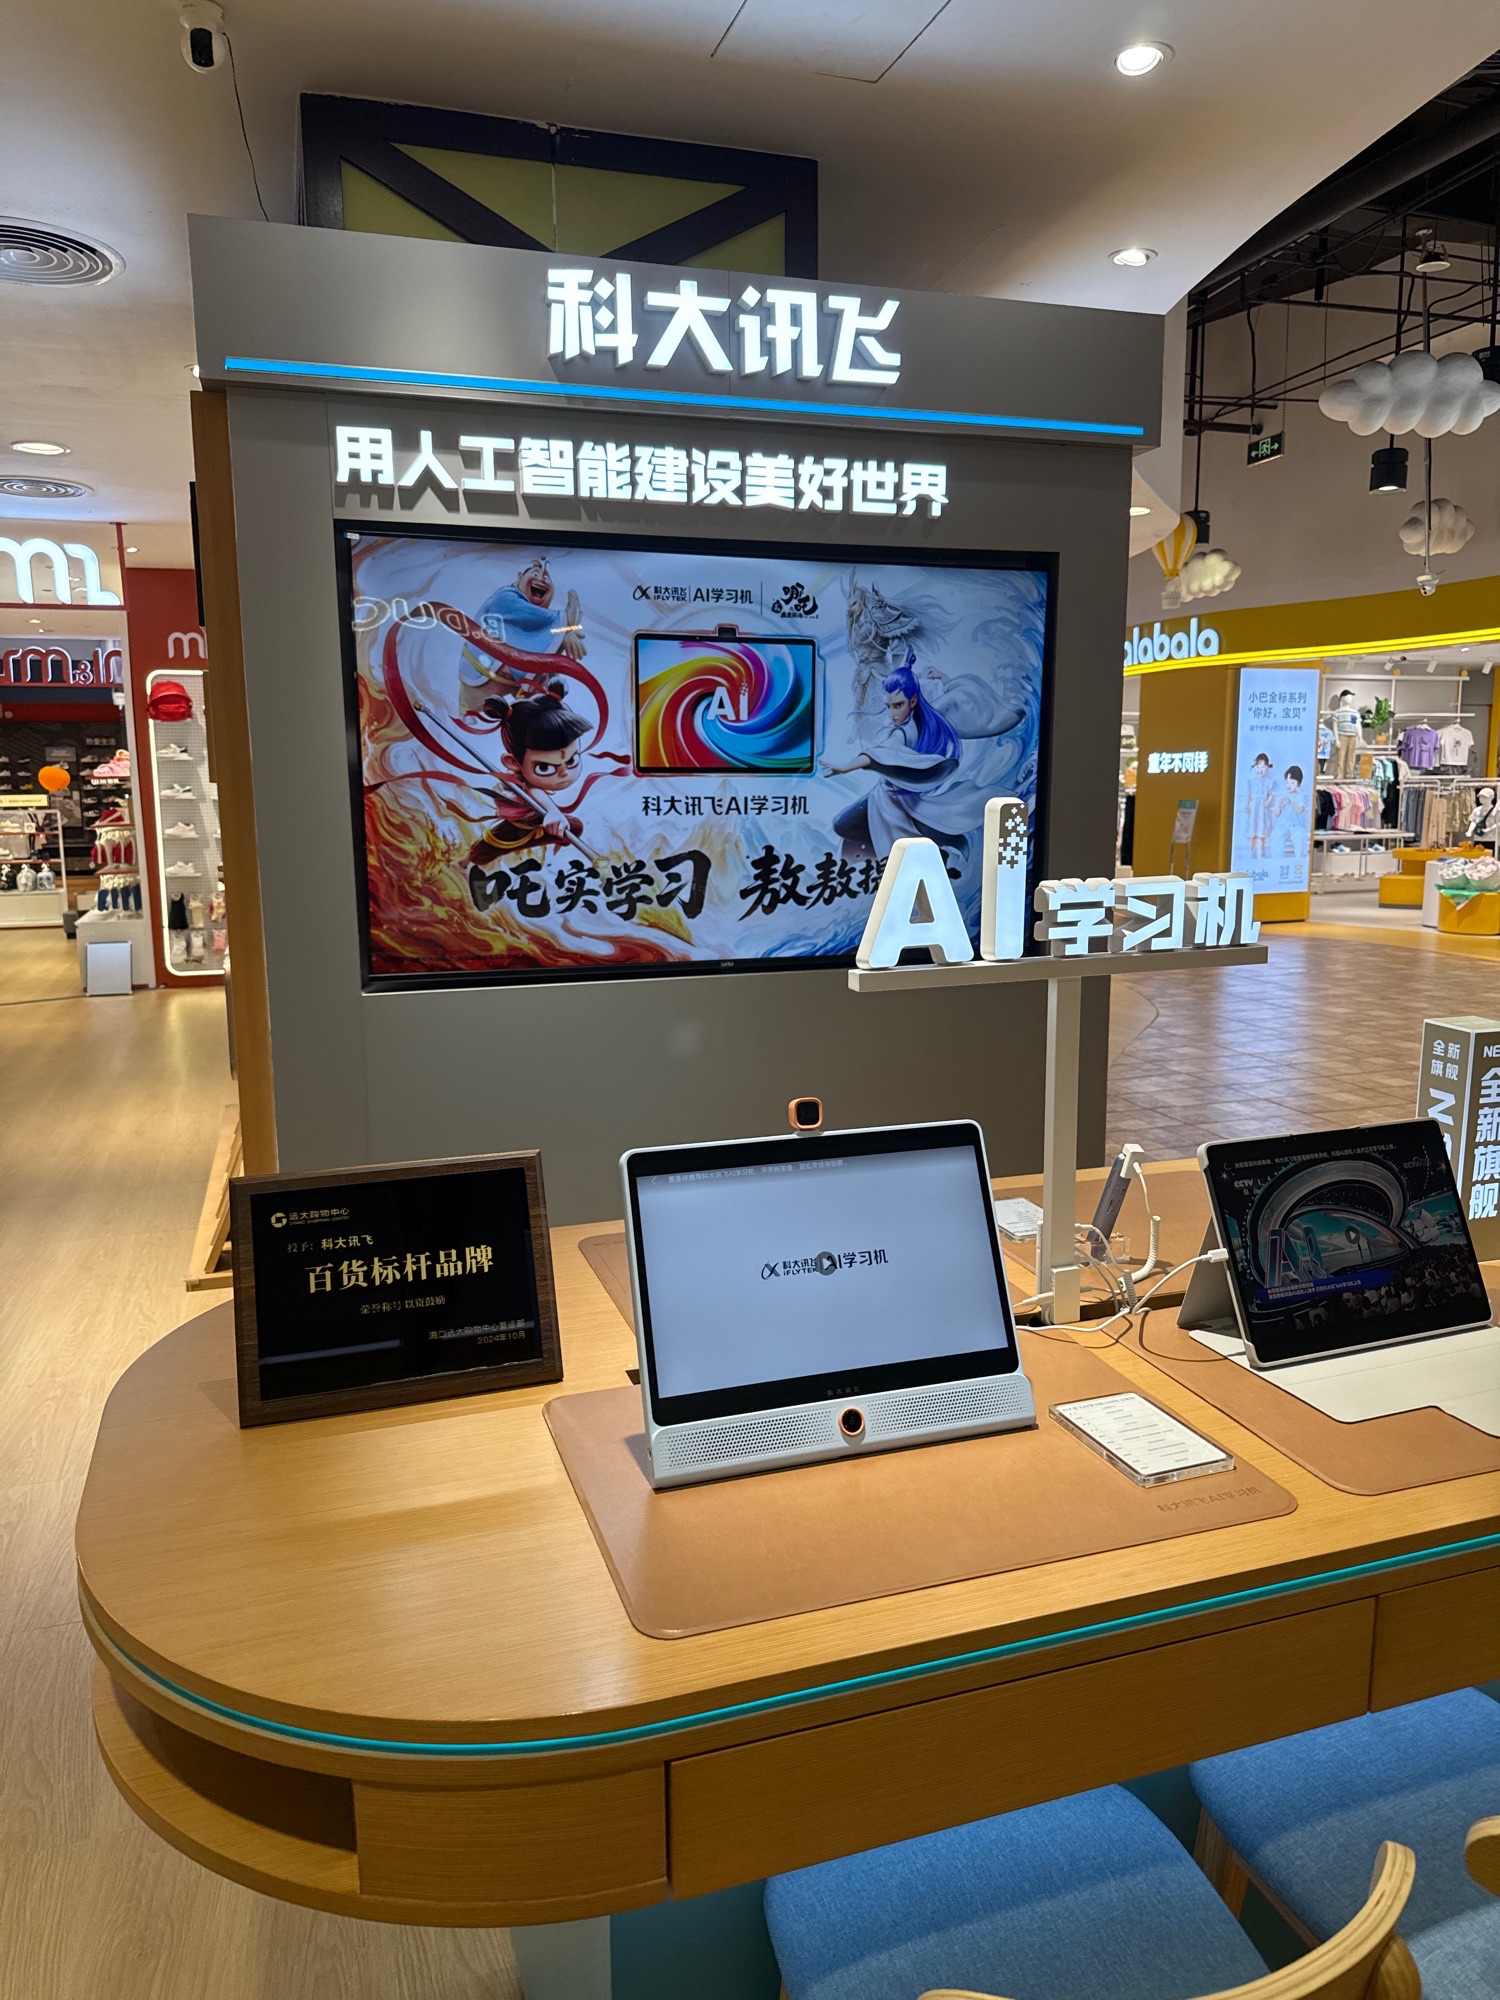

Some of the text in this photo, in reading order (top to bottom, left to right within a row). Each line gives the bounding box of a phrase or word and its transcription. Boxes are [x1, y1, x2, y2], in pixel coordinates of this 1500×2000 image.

[547, 268, 900, 386] 科大讯飞
[335, 425, 949, 519] 用人工智能建设美好世界
[653, 585, 754, 604] 科大讯飞 AI学习机
[706, 680, 748, 721] AI
[1248, 691, 1307, 704] 小巴金标系列
[641, 795, 810, 816] 科大讯飞AI学习机
[469, 848, 713, 921] 吒实学习
[857, 797, 1261, 970] AI学习机
[1432, 1039, 1461, 1061] 全新
[1430, 1059, 1459, 1081] 旗舰
[289, 1207, 350, 1221] 远大购物中心
[321, 1234, 374, 1251] 科大讯飞
[304, 1244, 494, 1294] 百货标杆品牌
[824, 1249, 889, 1271] AI学习机
[477, 1330, 526, 1345] 2024年10月
[1155, 1486, 1263, 1512] 科大讯飞AI学习机
